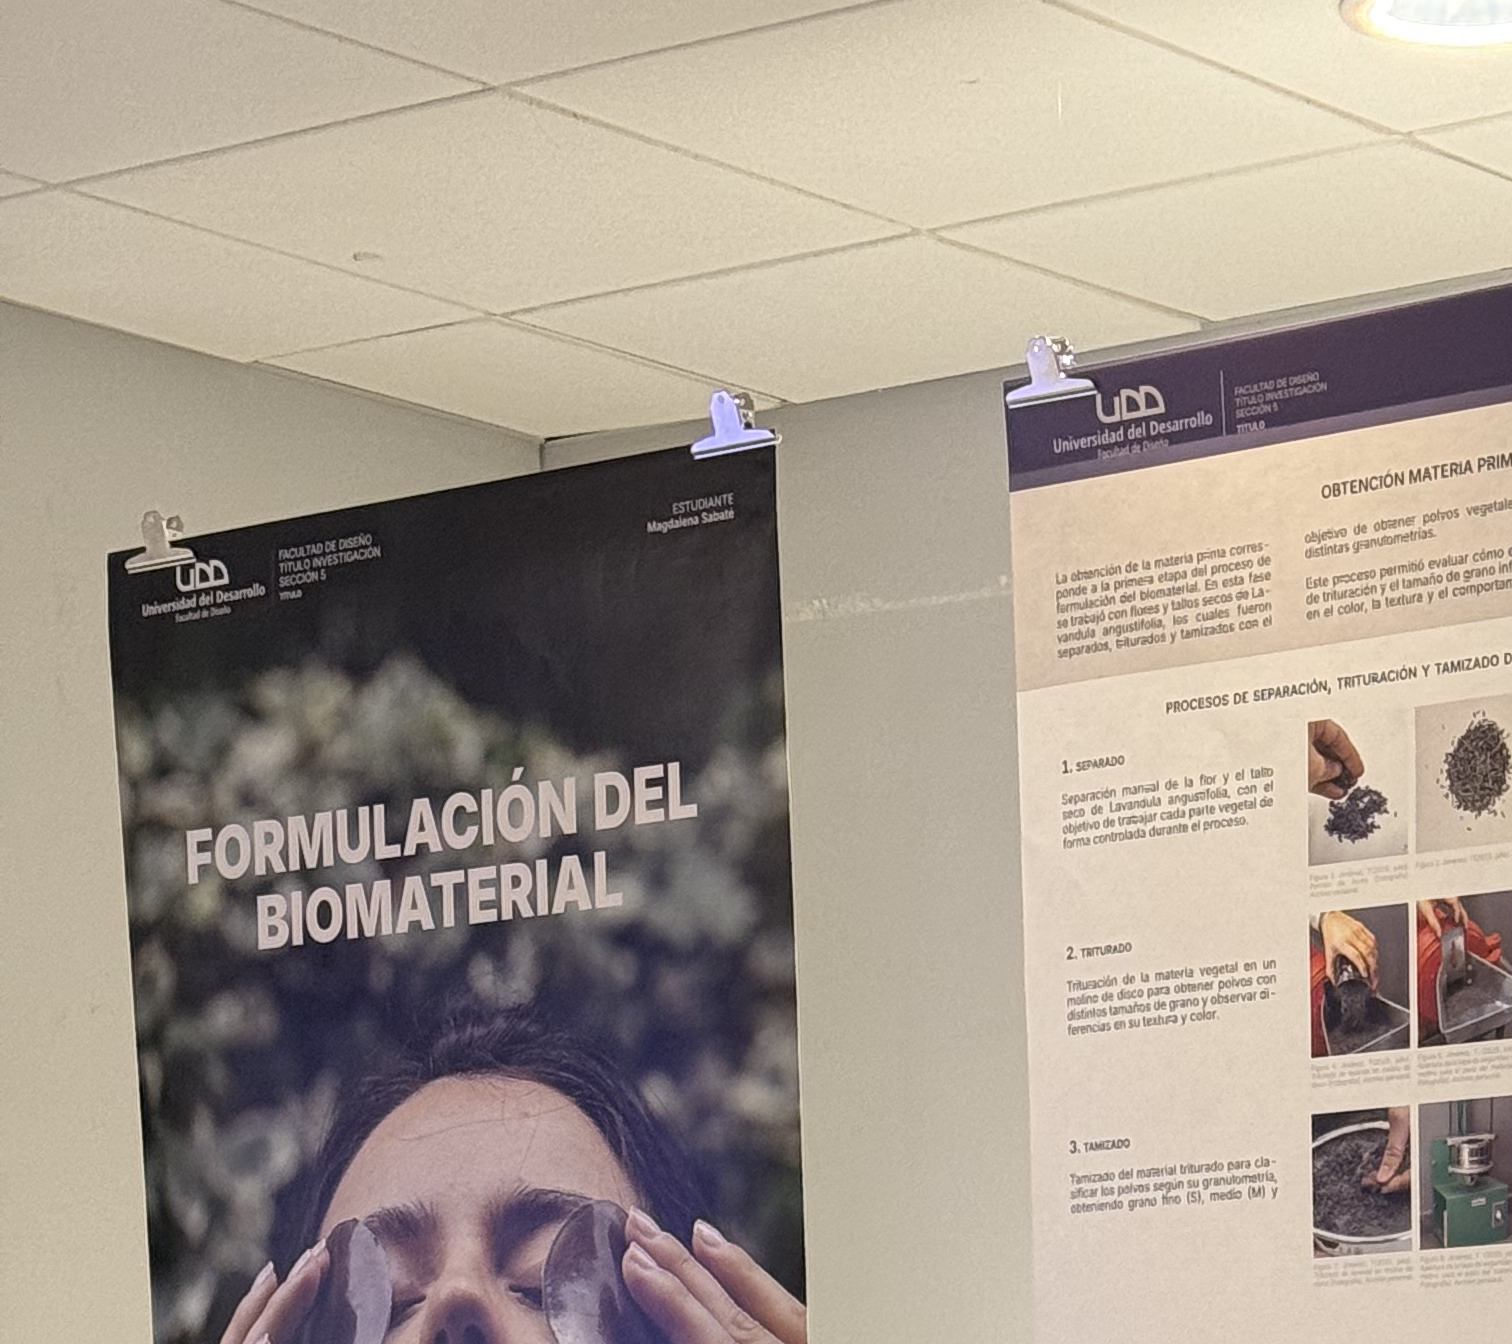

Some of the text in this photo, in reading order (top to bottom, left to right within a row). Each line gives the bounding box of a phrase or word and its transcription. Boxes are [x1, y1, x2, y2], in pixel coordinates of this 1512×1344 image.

[1234, 371, 1319, 396] FACULTAD DE DISEÑO
[1053, 411, 1212, 453] Universidad del Desarrollo
[1321, 471, 1404, 499] OBTENCIÓN
[1409, 459, 1473, 484] MATERIA
[672, 492, 734, 514] ESTUDIANTE
[646, 507, 735, 534] Magdalena Sabaté
[278, 534, 372, 560] FACULTAD DE DISEÑO
[279, 569, 326, 587] SECCIÓN 5
[142, 596, 196, 617] Universidad
[199, 592, 213, 606] del
[216, 583, 265, 603] Desarrollo
[1166, 693, 1229, 714] PROCESOS
[1234, 690, 1248, 705] DE
[1253, 678, 1331, 702] SEPARACIÓN,
[1337, 665, 1417, 690] TRITURACIÓN
[1422, 664, 1430, 677] Y
[1434, 654, 1499, 675] TAMIZADO
[1062, 754, 1125, 774] 1. SEPARADO
[186, 761, 697, 884] FORMULACIÓN DEL
[257, 850, 622, 950] BIOMATERIAL
[1066, 941, 1132, 960] 2. TRITURADO
[1070, 1138, 1130, 1154] 3. TAMIZADO
